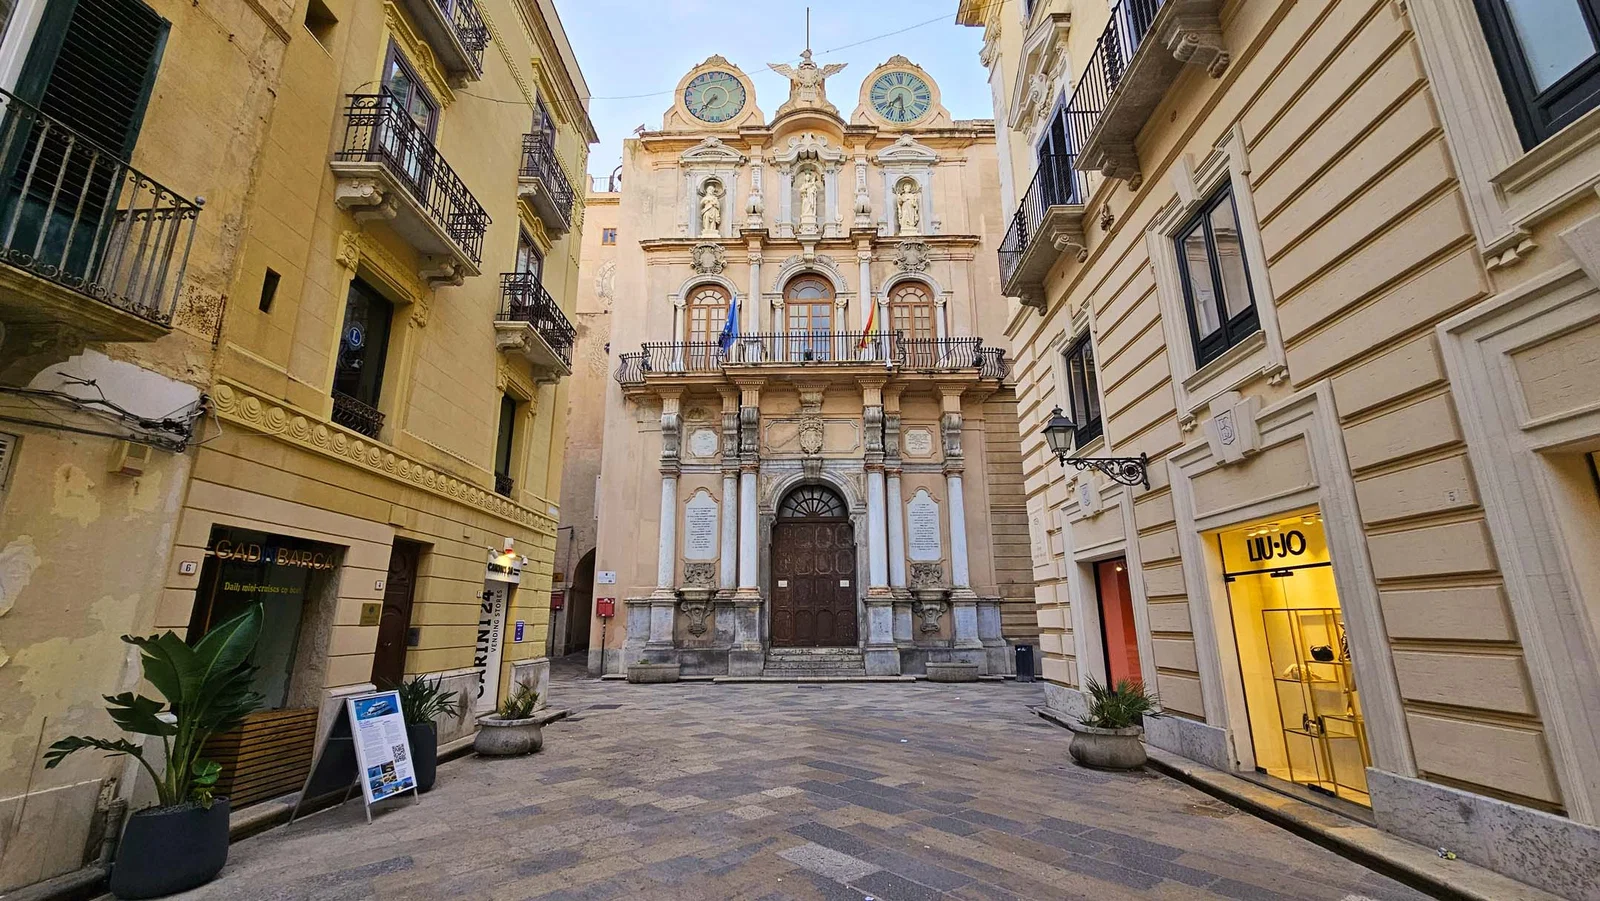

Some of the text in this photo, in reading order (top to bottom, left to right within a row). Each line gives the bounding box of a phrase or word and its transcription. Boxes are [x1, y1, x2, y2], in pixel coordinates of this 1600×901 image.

[185, 563, 192, 572] 6
[224, 581, 241, 592] Daily
[490, 589, 503, 653] VENDING STORES
